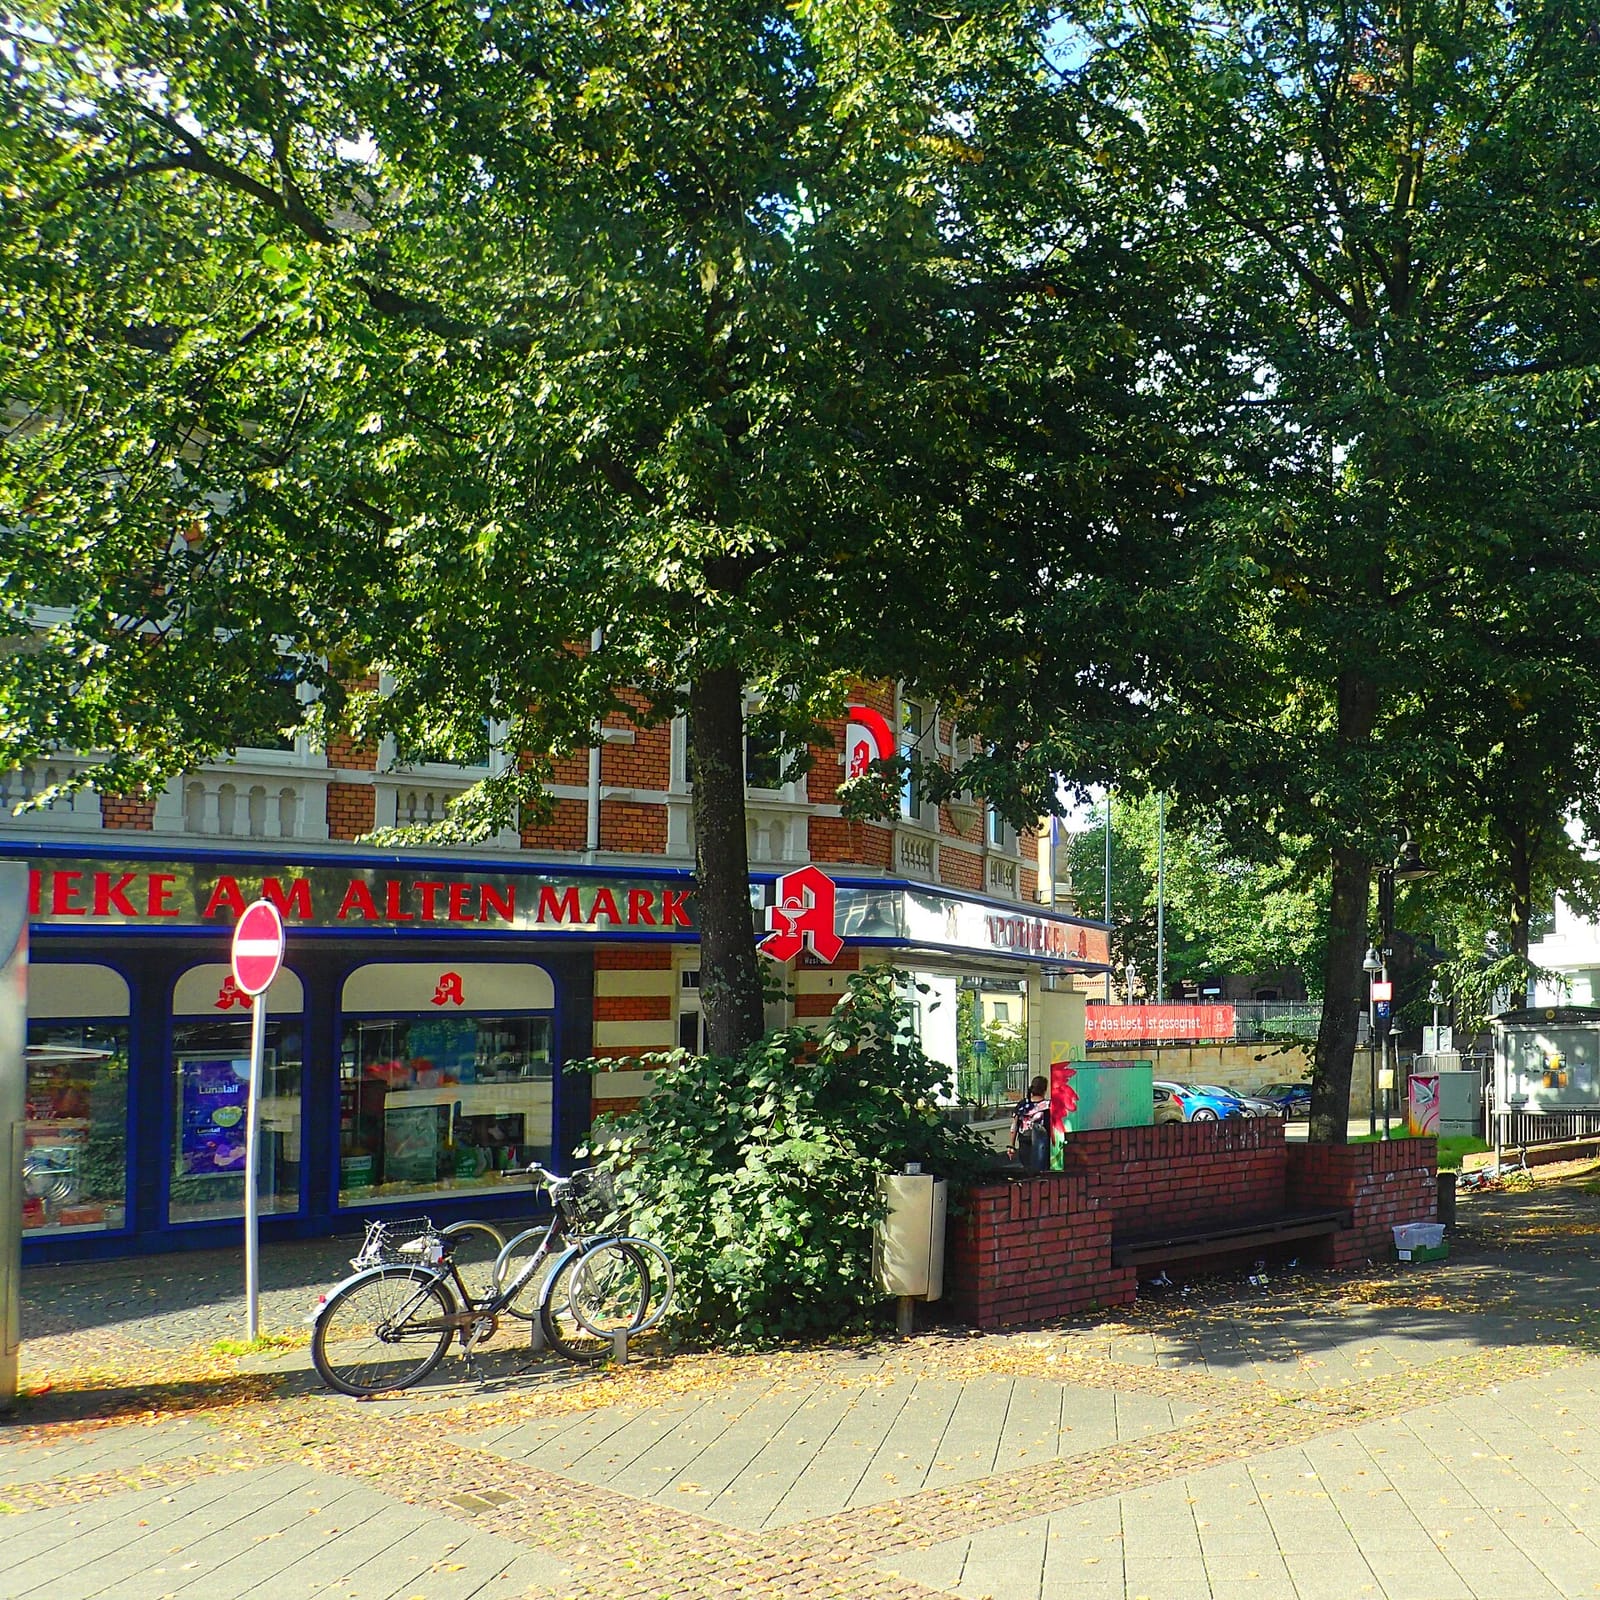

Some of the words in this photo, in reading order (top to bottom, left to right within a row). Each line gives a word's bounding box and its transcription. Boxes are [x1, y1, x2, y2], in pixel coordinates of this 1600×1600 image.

[203, 875, 314, 920] AM
[337, 879, 517, 923] ALTEN
[984, 914, 1060, 952] APOTHEKE
[1101, 1015, 1119, 1030] das
[1145, 1015, 1157, 1029] ist
[1159, 1016, 1202, 1032] gesegnet.
